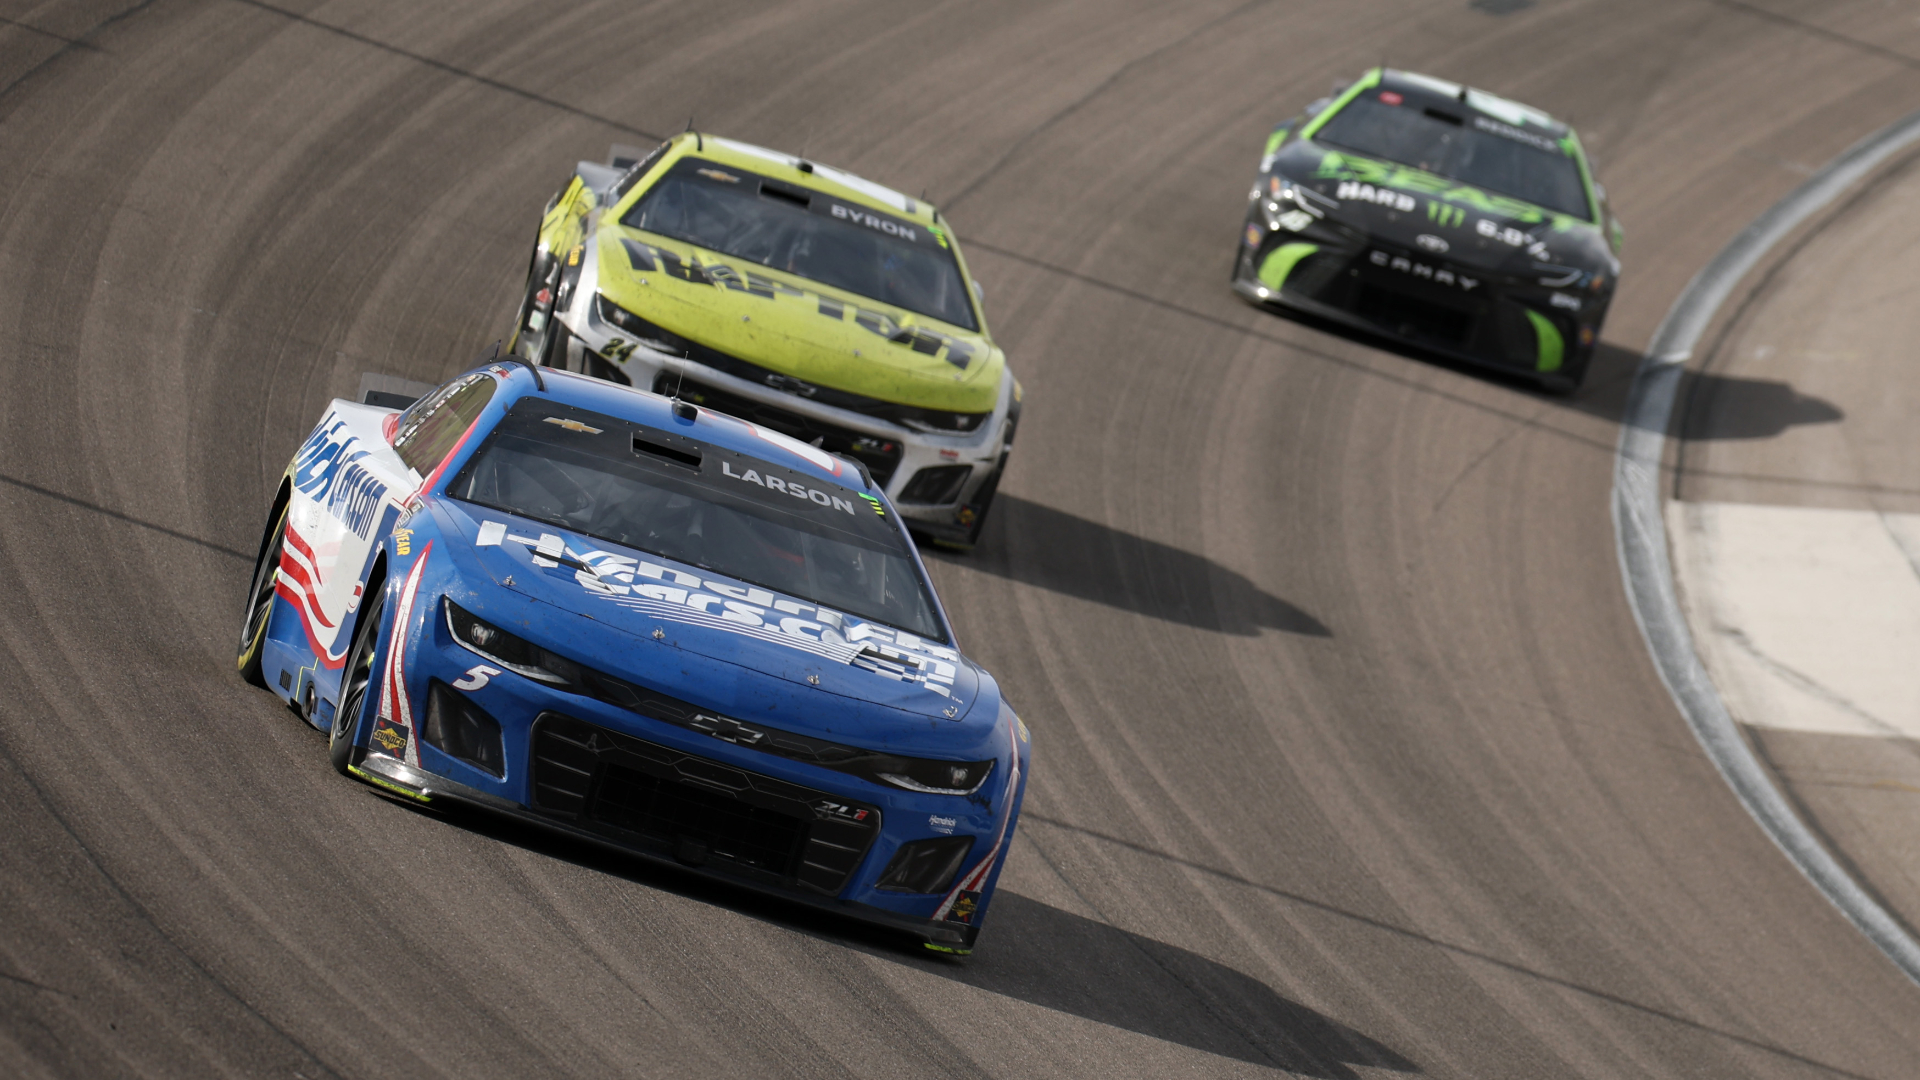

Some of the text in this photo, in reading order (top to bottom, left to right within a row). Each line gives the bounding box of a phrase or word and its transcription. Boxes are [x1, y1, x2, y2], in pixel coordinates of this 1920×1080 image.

[1336, 180, 1416, 212] HARD
[831, 204, 917, 242] BYRON
[1369, 249, 1480, 292] CAMRY
[599, 337, 639, 365] 24
[722, 461, 856, 516] LARSON
[475, 519, 958, 663] Hendrick
[451, 664, 504, 692] 5
[374, 730, 407, 748] SUNOCO
[815, 800, 869, 821] ZL1
